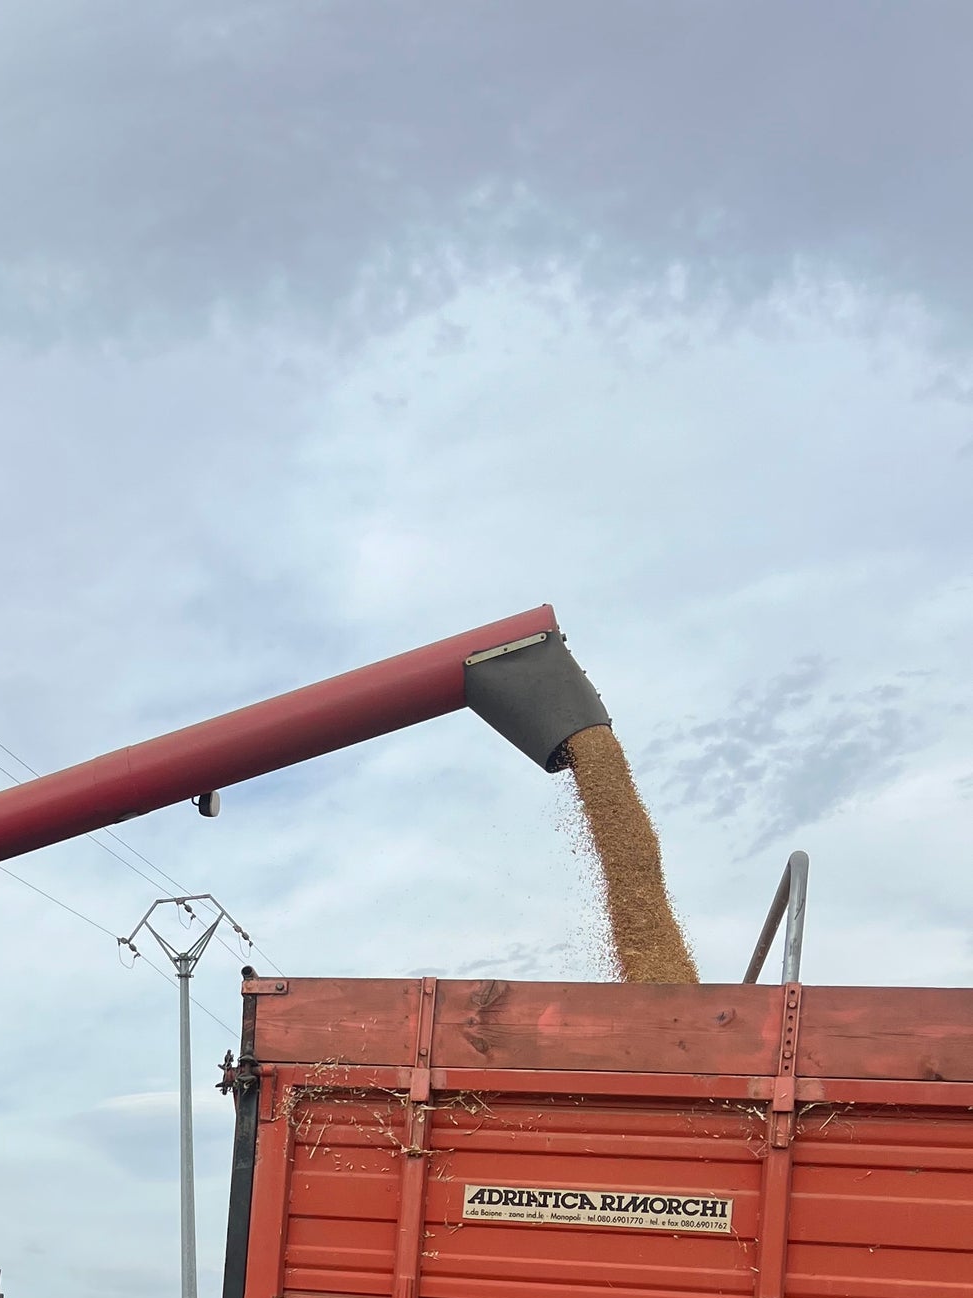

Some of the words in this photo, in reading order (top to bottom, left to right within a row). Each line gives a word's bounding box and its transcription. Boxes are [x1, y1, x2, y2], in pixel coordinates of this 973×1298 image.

[467, 1188, 597, 1211] ADRIATICA
[600, 1194, 729, 1218] RIMORCHI
[465, 1206, 479, 1216] c.da
[480, 1206, 503, 1217] Baione
[526, 1211, 544, 1219] ind.le
[550, 1213, 581, 1223] Monopoli
[587, 1214, 644, 1225] tel.080.6901770
[650, 1218, 660, 1226] tel.
[667, 1218, 678, 1227] fax
[680, 1221, 728, 1230] 080.6901762
